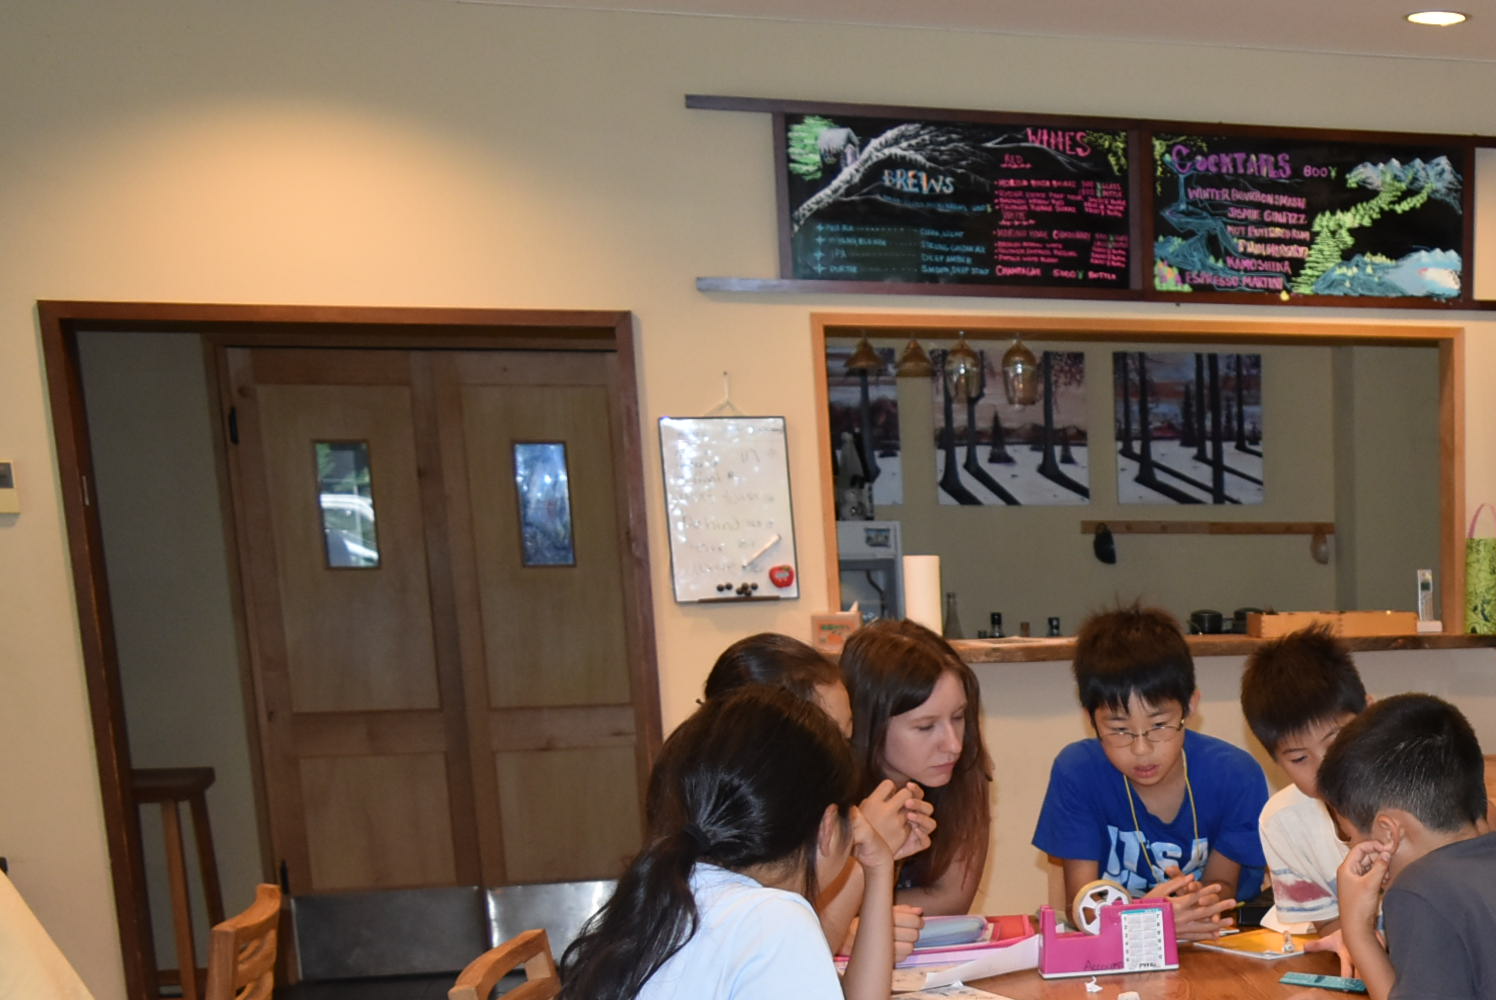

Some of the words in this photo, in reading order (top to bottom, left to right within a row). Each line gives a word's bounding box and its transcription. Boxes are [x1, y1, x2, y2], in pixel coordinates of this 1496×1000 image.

[1026, 127, 1091, 157] WINES
[1004, 154, 1025, 165] RED
[1172, 144, 1292, 179] COCKTAILS
[882, 168, 955, 195] BREWS
[1188, 187, 1230, 201] WINTER
